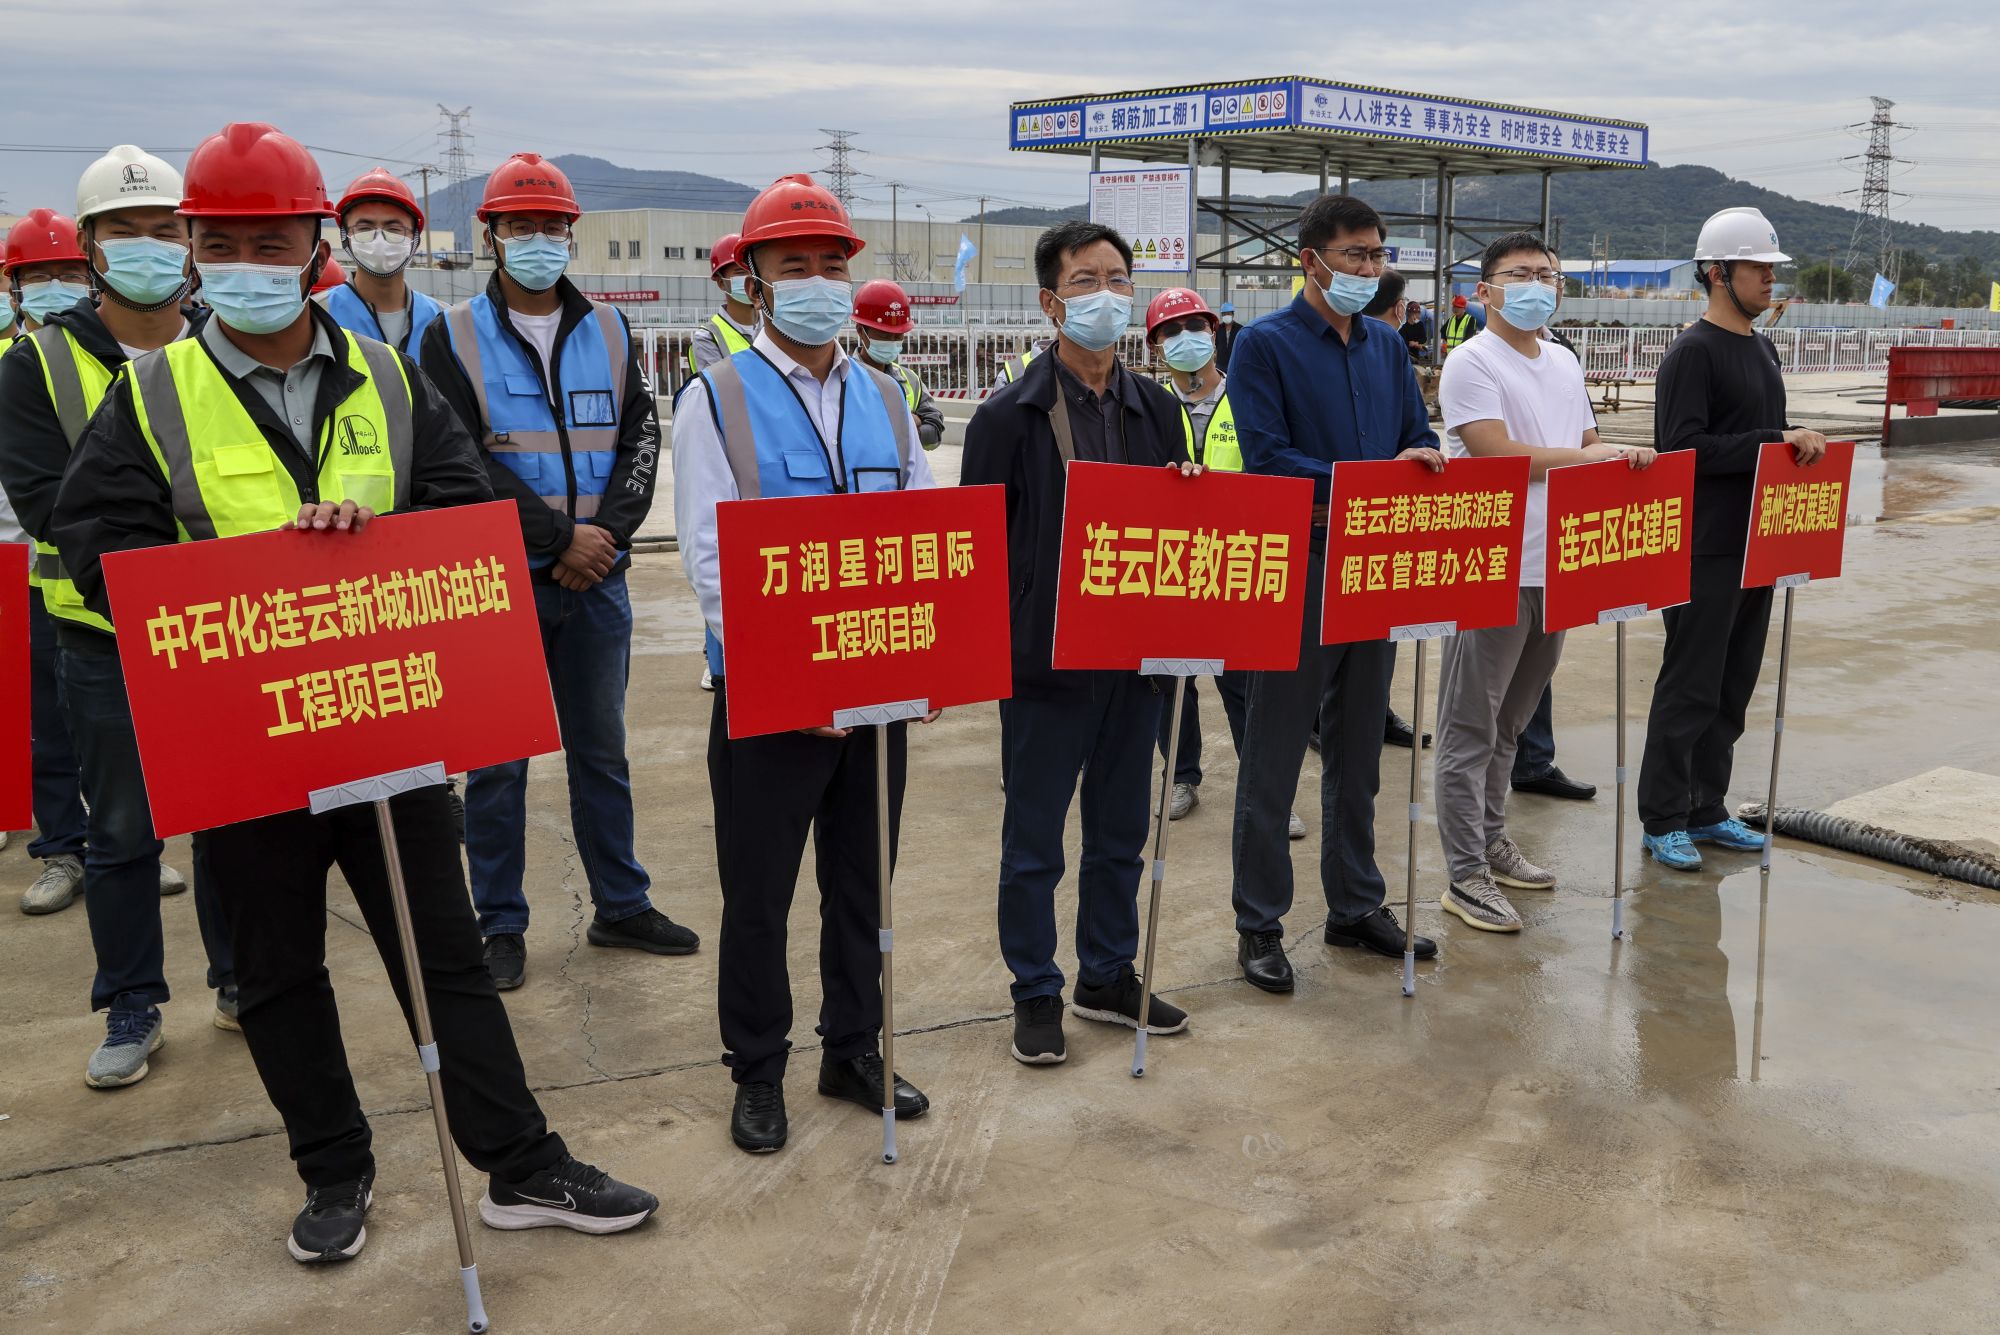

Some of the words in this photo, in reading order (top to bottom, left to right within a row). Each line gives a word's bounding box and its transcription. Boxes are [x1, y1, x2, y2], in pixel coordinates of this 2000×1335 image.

[1111, 103, 1198, 131] 钢筋加工棚1
[1338, 96, 1412, 129] 人人讲安全
[1423, 106, 1491, 139] 事事为安全
[1501, 118, 1563, 147] 时时想安全
[1571, 127, 1630, 155] 处处要安全
[1099, 174, 1136, 184] 遵守操作规程
[1142, 173, 1180, 183] 严禁违章操作
[272, 277, 294, 286] BST
[1344, 489, 1514, 537] 连云港海滨旅游度
[1558, 496, 1683, 574] 连云区住建局
[1757, 481, 1842, 538] 海州湾发展集团
[760, 530, 974, 597] 万润星河国际
[1080, 521, 1290, 603] 连云区教育局
[1340, 544, 1509, 595] 假区管理办公室
[146, 555, 511, 670] 中石化连云新城加油站
[811, 601, 936, 661] 工程项目部
[260, 650, 443, 738] 工程项目部
